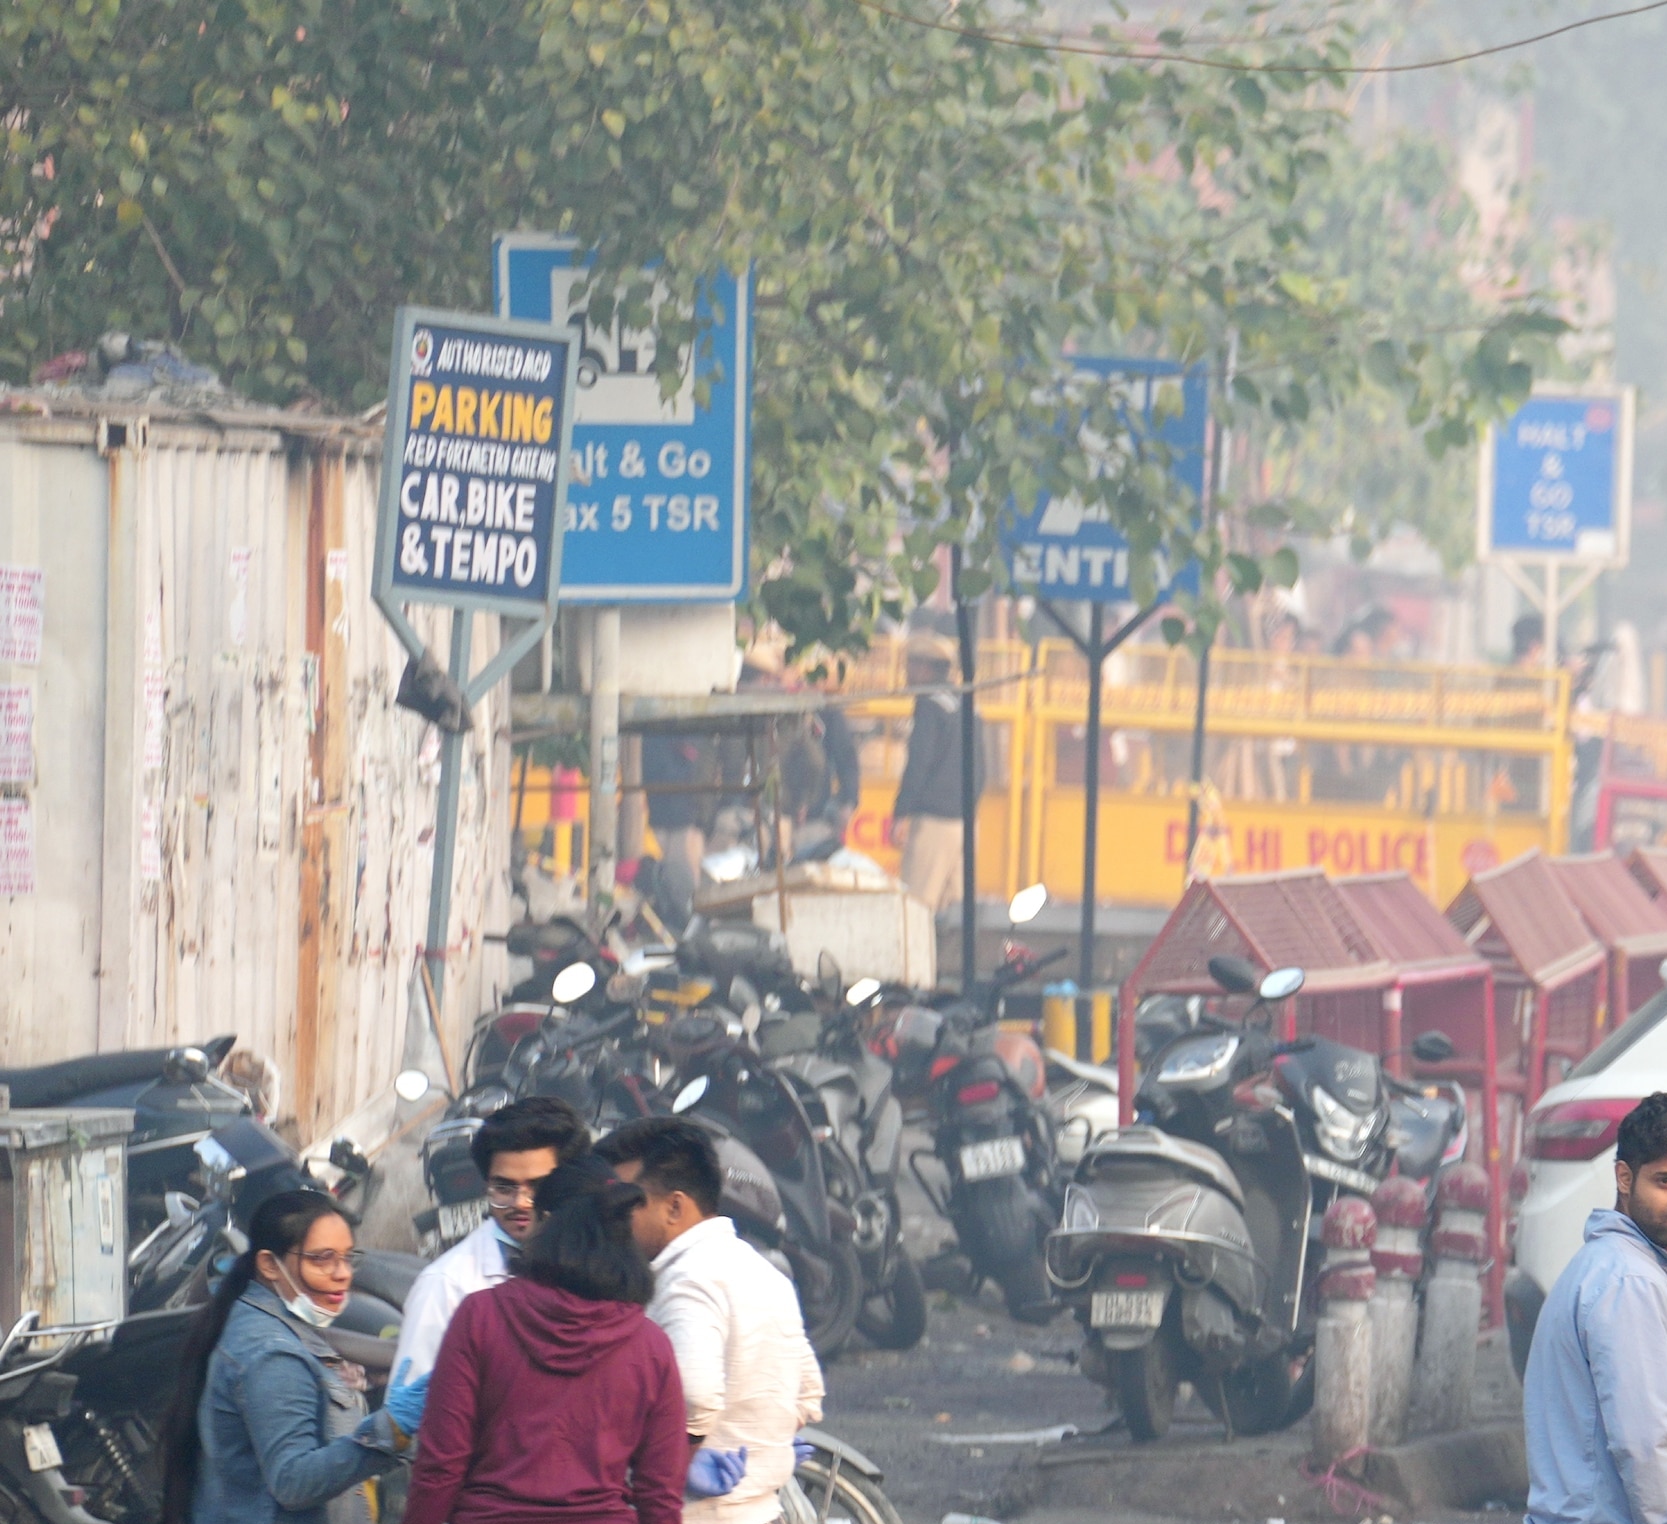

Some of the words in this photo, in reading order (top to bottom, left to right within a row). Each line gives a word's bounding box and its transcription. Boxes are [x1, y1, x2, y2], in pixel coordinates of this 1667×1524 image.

[410, 380, 555, 445] PARKING
[404, 432, 437, 467] RED
[436, 436, 472, 473] FORT
[510, 445, 540, 480] GATE
[568, 441, 608, 480] alt
[619, 440, 646, 479] &
[658, 440, 712, 479] Go
[564, 502, 599, 533] ax
[611, 494, 632, 532] 5
[642, 494, 720, 532] TSR
[1012, 543, 1175, 590] ENT
[1165, 820, 1283, 874] DLHI
